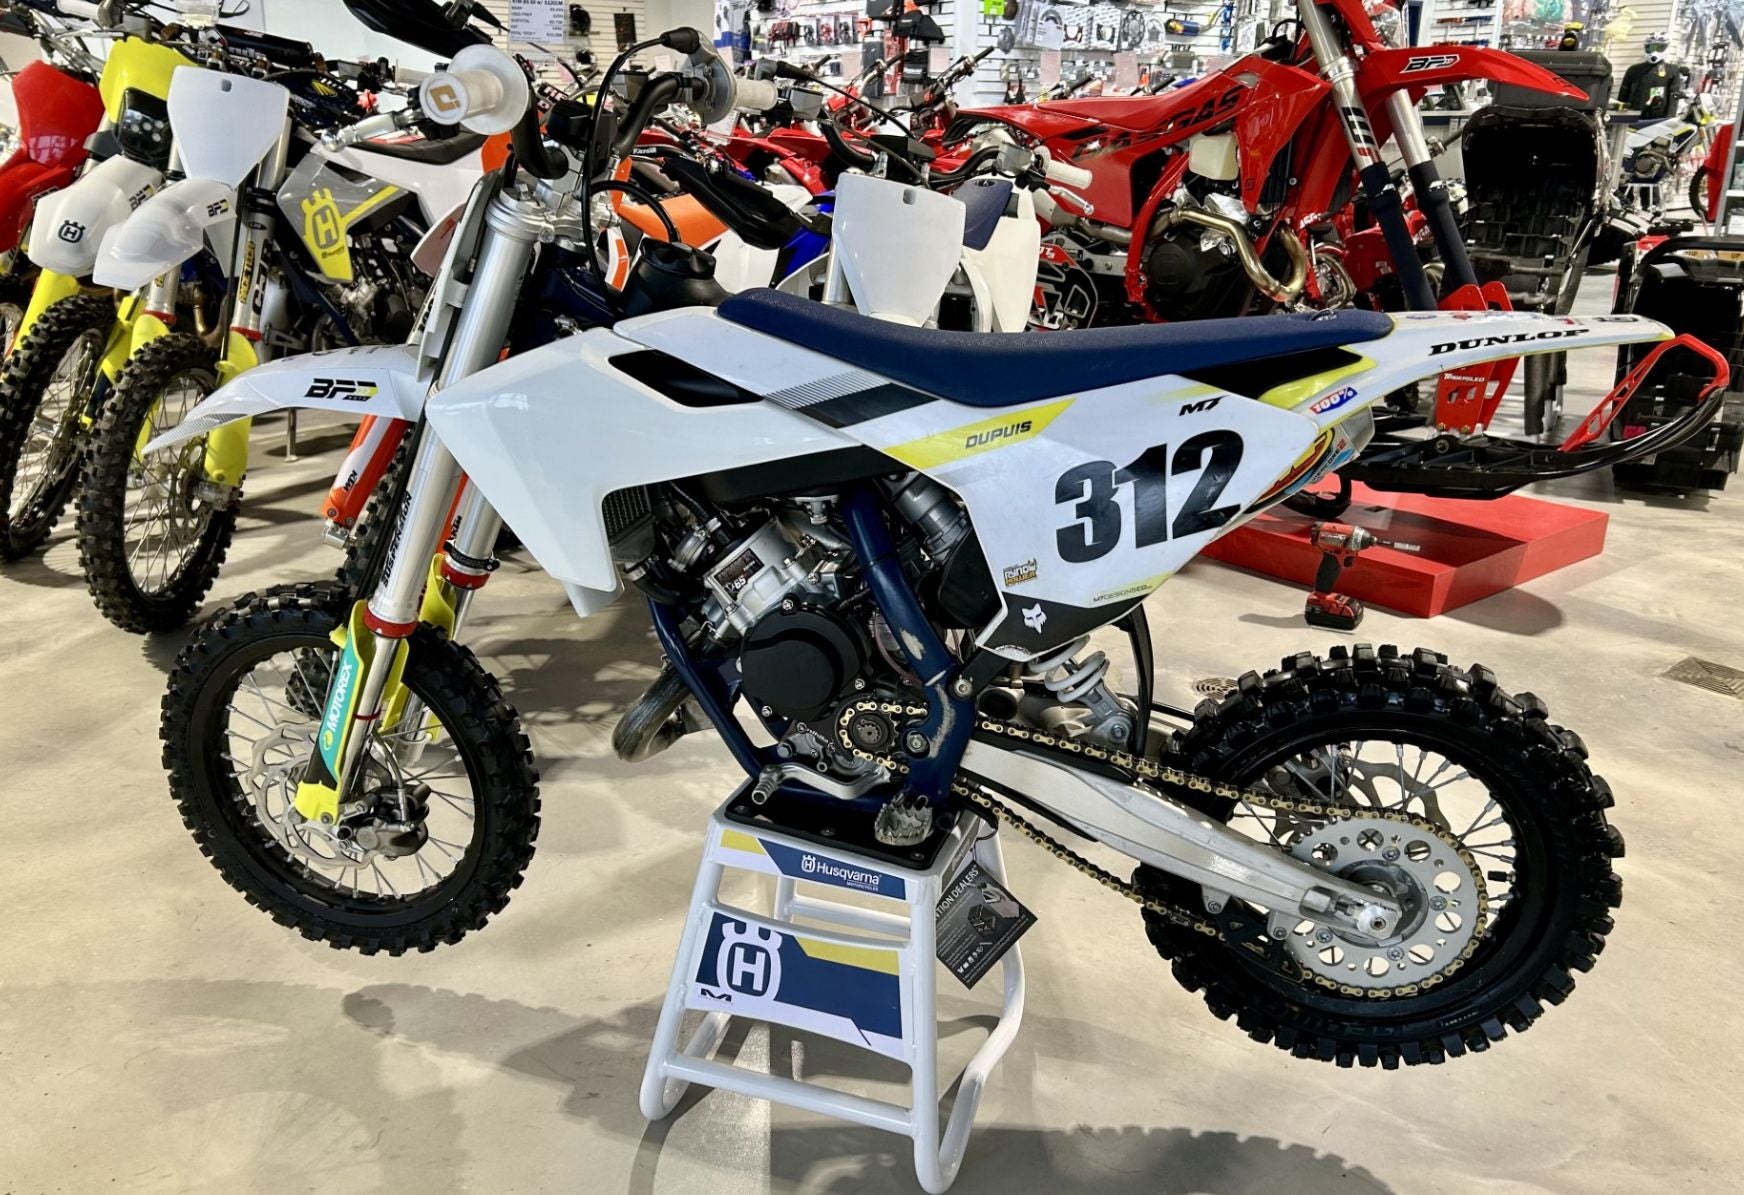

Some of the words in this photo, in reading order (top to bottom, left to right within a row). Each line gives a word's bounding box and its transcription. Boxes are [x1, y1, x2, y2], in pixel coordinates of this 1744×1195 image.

[1428, 328, 1590, 356] DUNLOP
[304, 378, 379, 400] BFD
[1311, 386, 1355, 414] 100%
[1178, 394, 1231, 417] M7
[965, 420, 1033, 449] DUPUIS
[1055, 429, 1244, 564] 312
[382, 490, 413, 588] SUSPENSION
[733, 574, 747, 590] 65
[326, 661, 353, 733] MOTOREX
[816, 861, 880, 886] Husqvarna
[950, 864, 979, 899] DEALERS
